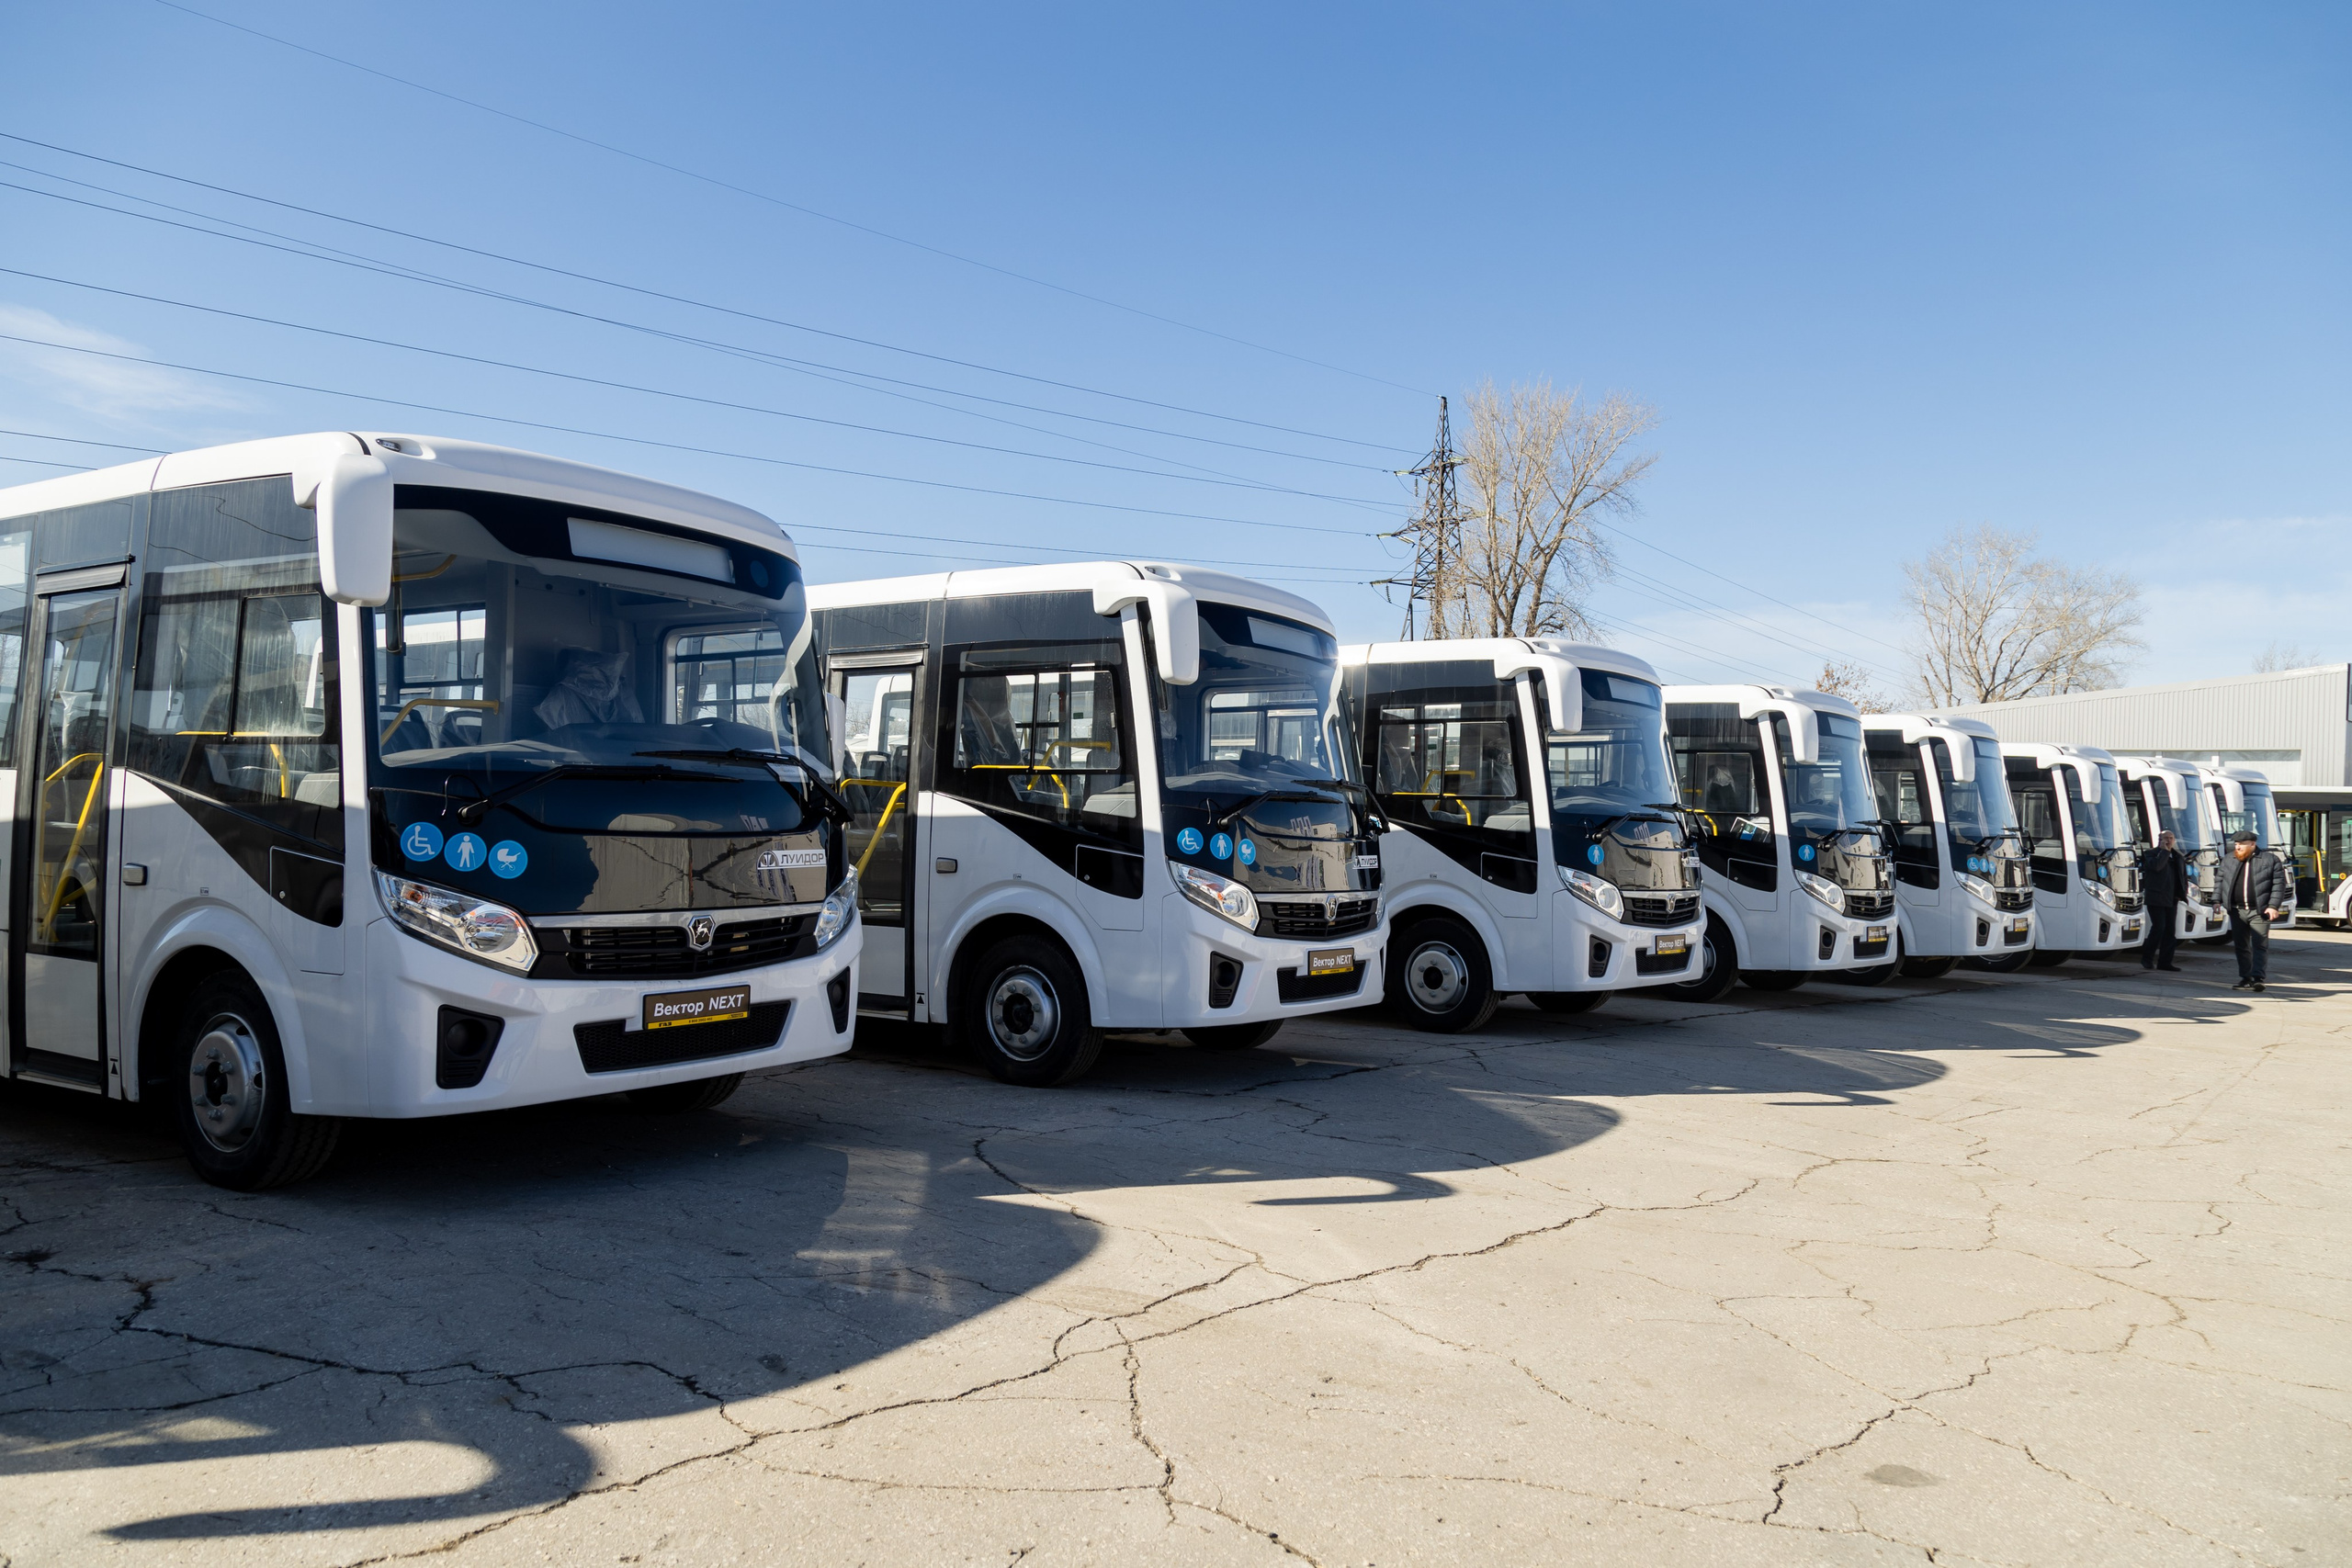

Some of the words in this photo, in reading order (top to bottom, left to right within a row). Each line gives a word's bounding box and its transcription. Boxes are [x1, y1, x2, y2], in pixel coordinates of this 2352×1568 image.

[781, 853, 824, 865] ЛУИДОР
[1313, 956, 1335, 968] Вектор
[1336, 954, 1352, 964] NEXT
[653, 1001, 705, 1017] Вектор
[708, 994, 745, 1010] NEXT
